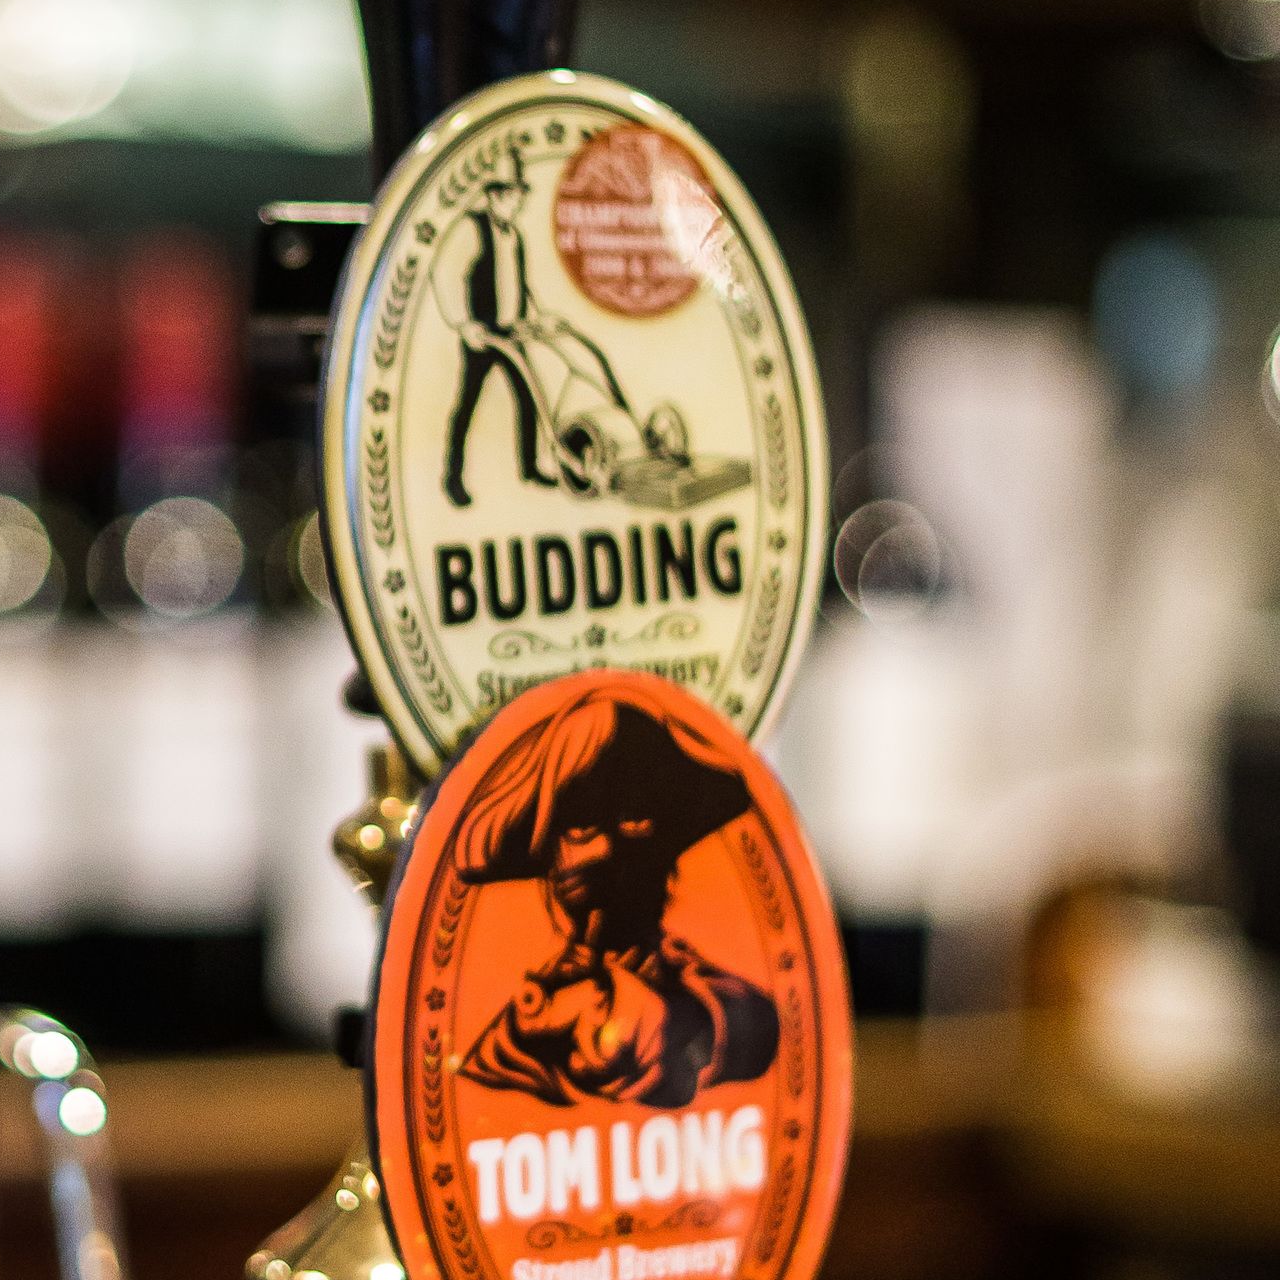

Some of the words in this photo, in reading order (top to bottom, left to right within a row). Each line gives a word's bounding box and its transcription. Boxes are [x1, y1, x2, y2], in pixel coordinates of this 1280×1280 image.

[436, 517, 745, 625] BUDDING
[468, 1126, 600, 1225] TOM
[610, 1104, 766, 1205] LONG
